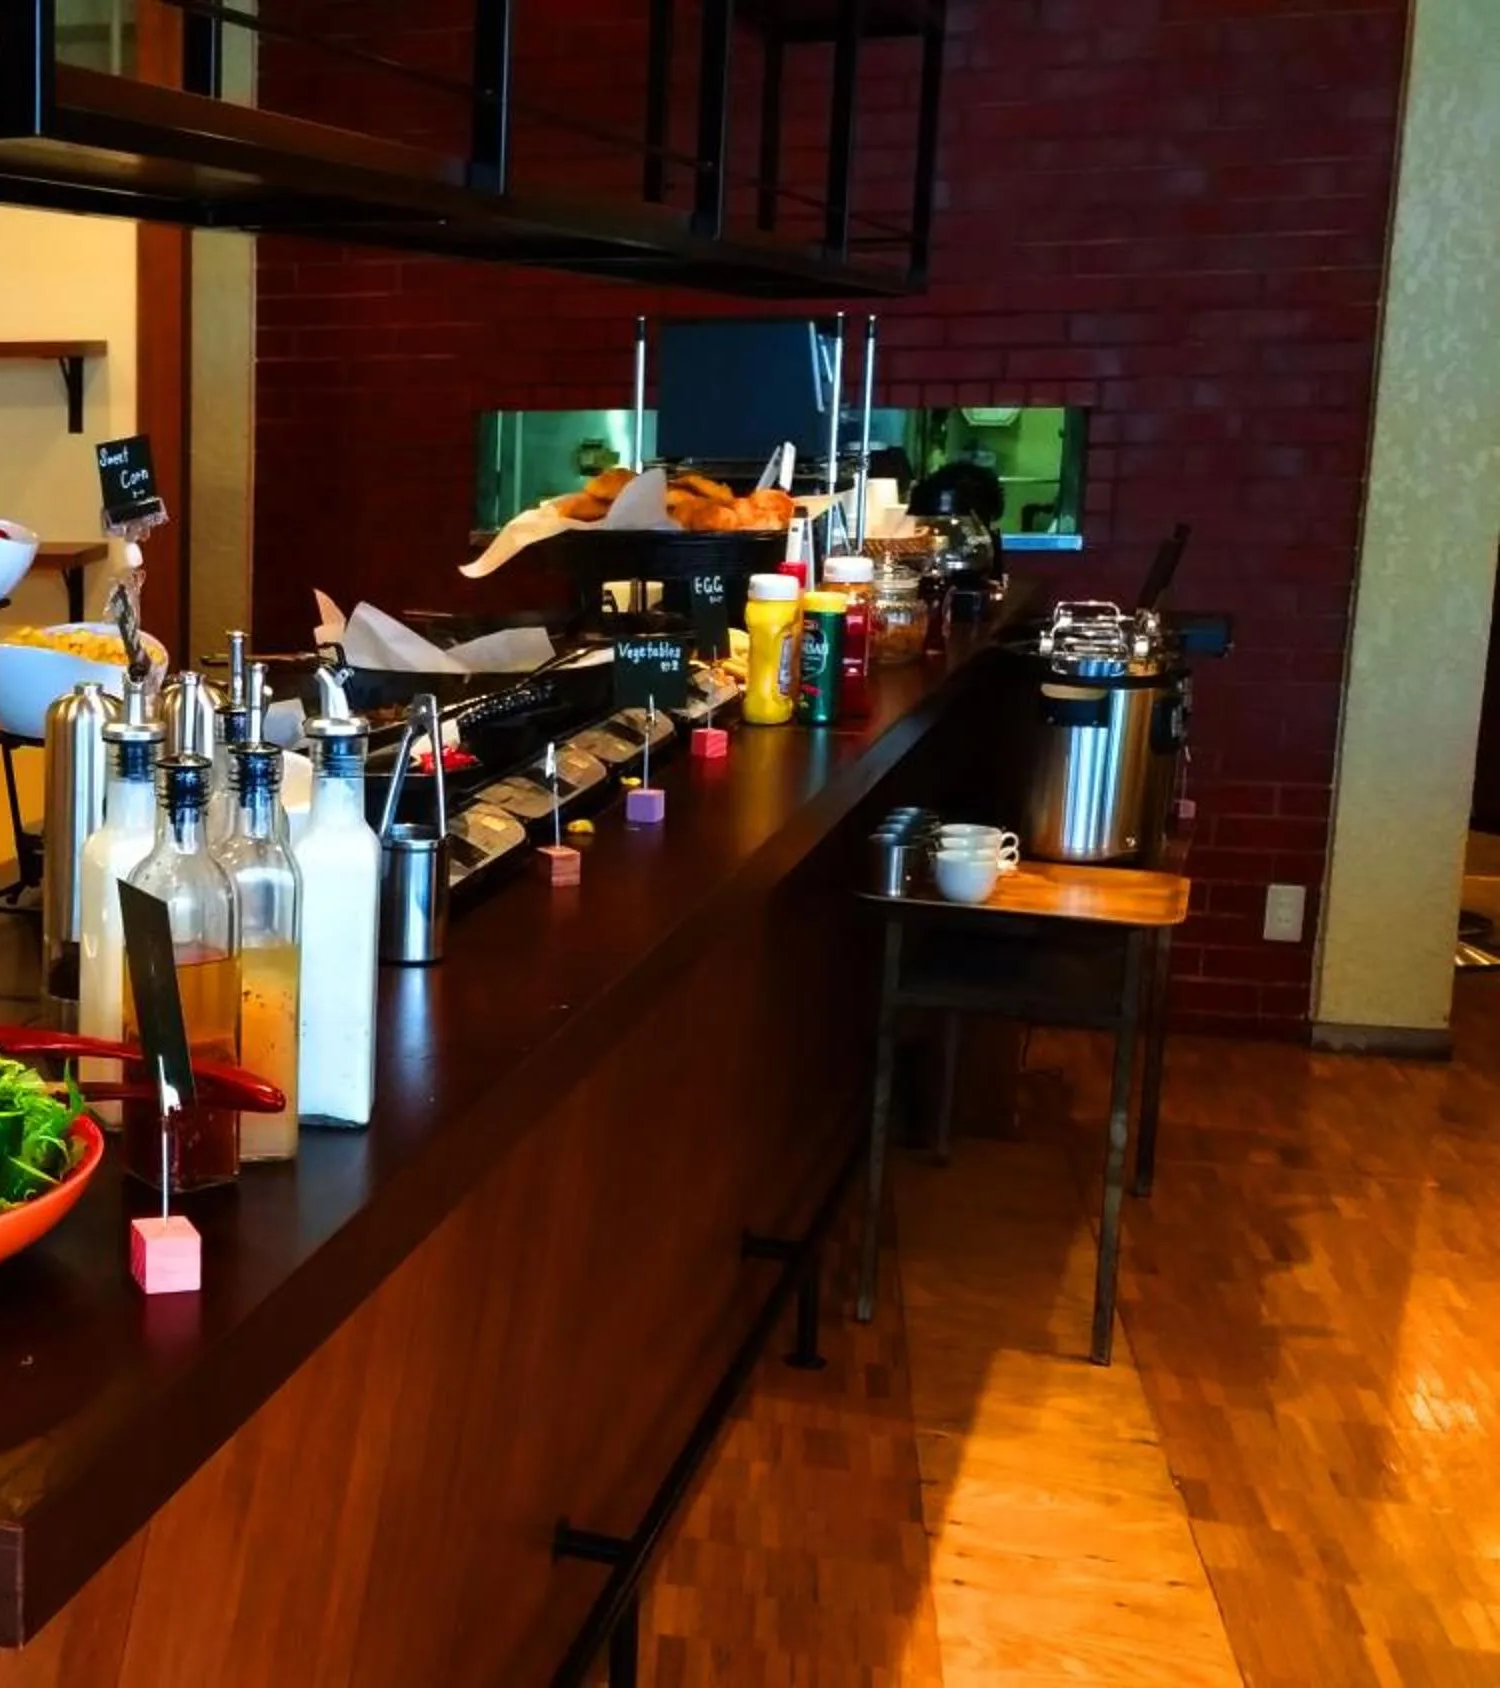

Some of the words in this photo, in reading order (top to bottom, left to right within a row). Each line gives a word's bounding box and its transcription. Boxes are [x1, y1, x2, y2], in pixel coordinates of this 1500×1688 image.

[99, 445, 129, 468] Sweet
[120, 469, 149, 489] Corn
[694, 575, 724, 595] EGG
[617, 641, 681, 664] Vegetables
